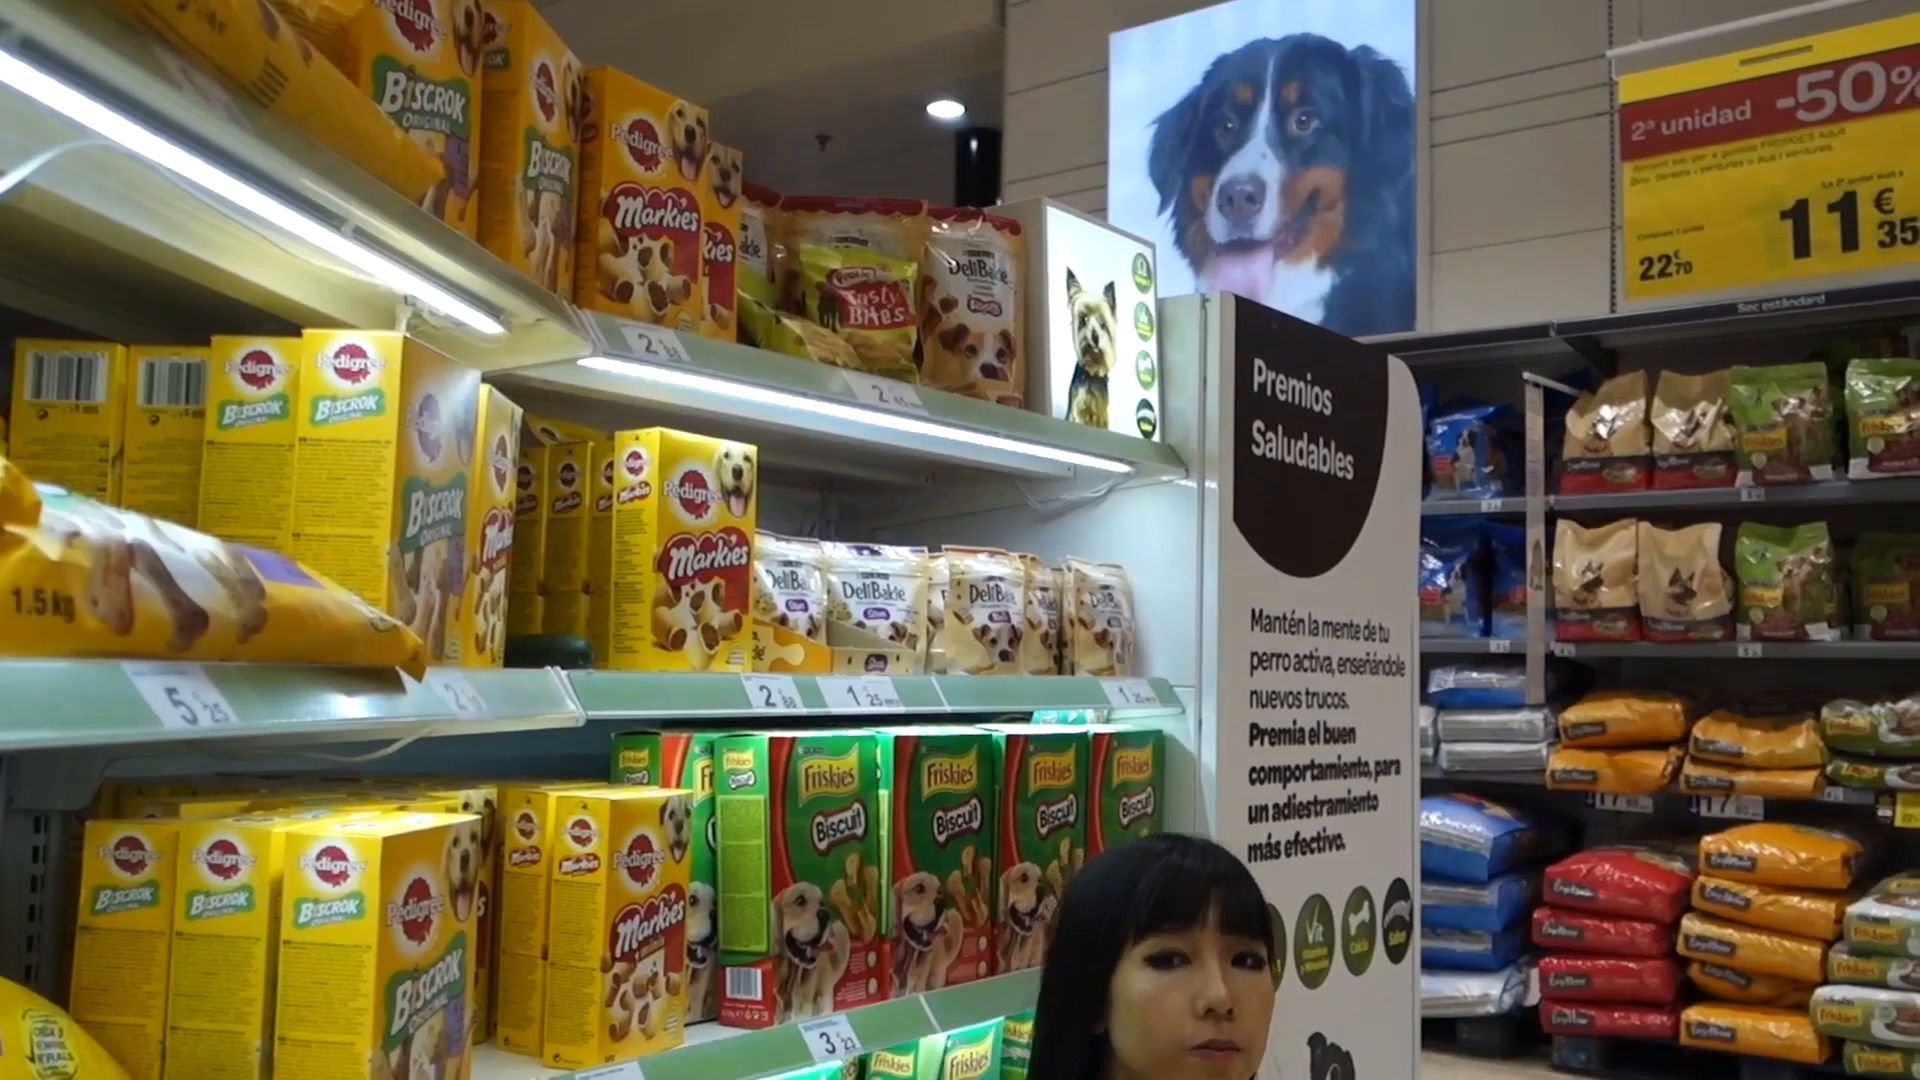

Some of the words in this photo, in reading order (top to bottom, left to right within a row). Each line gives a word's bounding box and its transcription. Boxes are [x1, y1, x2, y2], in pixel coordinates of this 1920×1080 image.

[1631, 119, 1655, 141] 2ª
[1660, 100, 1753, 136] unidad
[1776, 60, 1920, 122] -50%
[611, 119, 674, 159] Pedigree
[615, 194, 699, 232] Markies
[1874, 187, 1895, 215] €
[1780, 189, 1860, 261] 11
[1877, 216, 1920, 248] 35
[701, 234, 735, 263] kies
[1639, 254, 1673, 281] 22
[1674, 260, 1693, 276] 70
[844, 285, 898, 309] Tasty
[1737, 302, 1760, 314] Sec
[848, 305, 905, 327] Bites
[637, 333, 658, 354] 2
[224, 356, 292, 377] Pedigree
[315, 353, 387, 371] Pedigree
[871, 384, 888, 403] 2
[1252, 357, 1334, 417] Premios
[1250, 419, 1355, 481] Saludables
[663, 479, 722, 503] Pedigree
[667, 536, 750, 580] Markies
[841, 579, 907, 602] DeliBakie
[1250, 607, 1305, 637] Mantén
[1307, 611, 1320, 638] la
[1321, 617, 1361, 641] mente
[1362, 618, 1377, 643] de
[1379, 622, 1390, 643] tu
[1250, 649, 1291, 677] perro
[1292, 648, 1336, 677] activa,
[1336, 652, 1406, 678] enseñándole
[163, 686, 199, 726] 5
[759, 685, 776, 708] 2
[846, 685, 859, 708] 1
[865, 694, 882, 708] 25
[1117, 686, 1129, 703] 1
[1249, 688, 1303, 710] nuevos
[1304, 686, 1350, 710] trucos.
[1249, 719, 1306, 747] Premia
[1308, 720, 1321, 746] el
[1323, 720, 1357, 745] buen
[804, 763, 857, 793] Friskies
[926, 762, 975, 789] Friskies
[1032, 759, 1073, 787] Friskies
[1115, 752, 1150, 778] Friskies
[1248, 754, 1373, 790] comportamiento,
[1374, 758, 1401, 784] para
[1039, 798, 1076, 830] Biscuit
[1121, 787, 1153, 819] Biscuit
[1247, 803, 1270, 825] un
[1271, 788, 1380, 821] adiestramiento
[815, 807, 864, 845] Biscuit
[935, 799, 979, 836] Biscuit
[1246, 832, 1281, 864] más
[1283, 826, 1346, 859] efectivo.
[299, 855, 366, 873] Pedigree
[613, 849, 665, 871] Pedigree
[386, 894, 446, 929] Pedigree
[614, 891, 686, 959] Markies
[819, 1031, 837, 1055] 3
[871, 1049, 912, 1075] Friskies
[949, 1049, 991, 1080] Friskies
